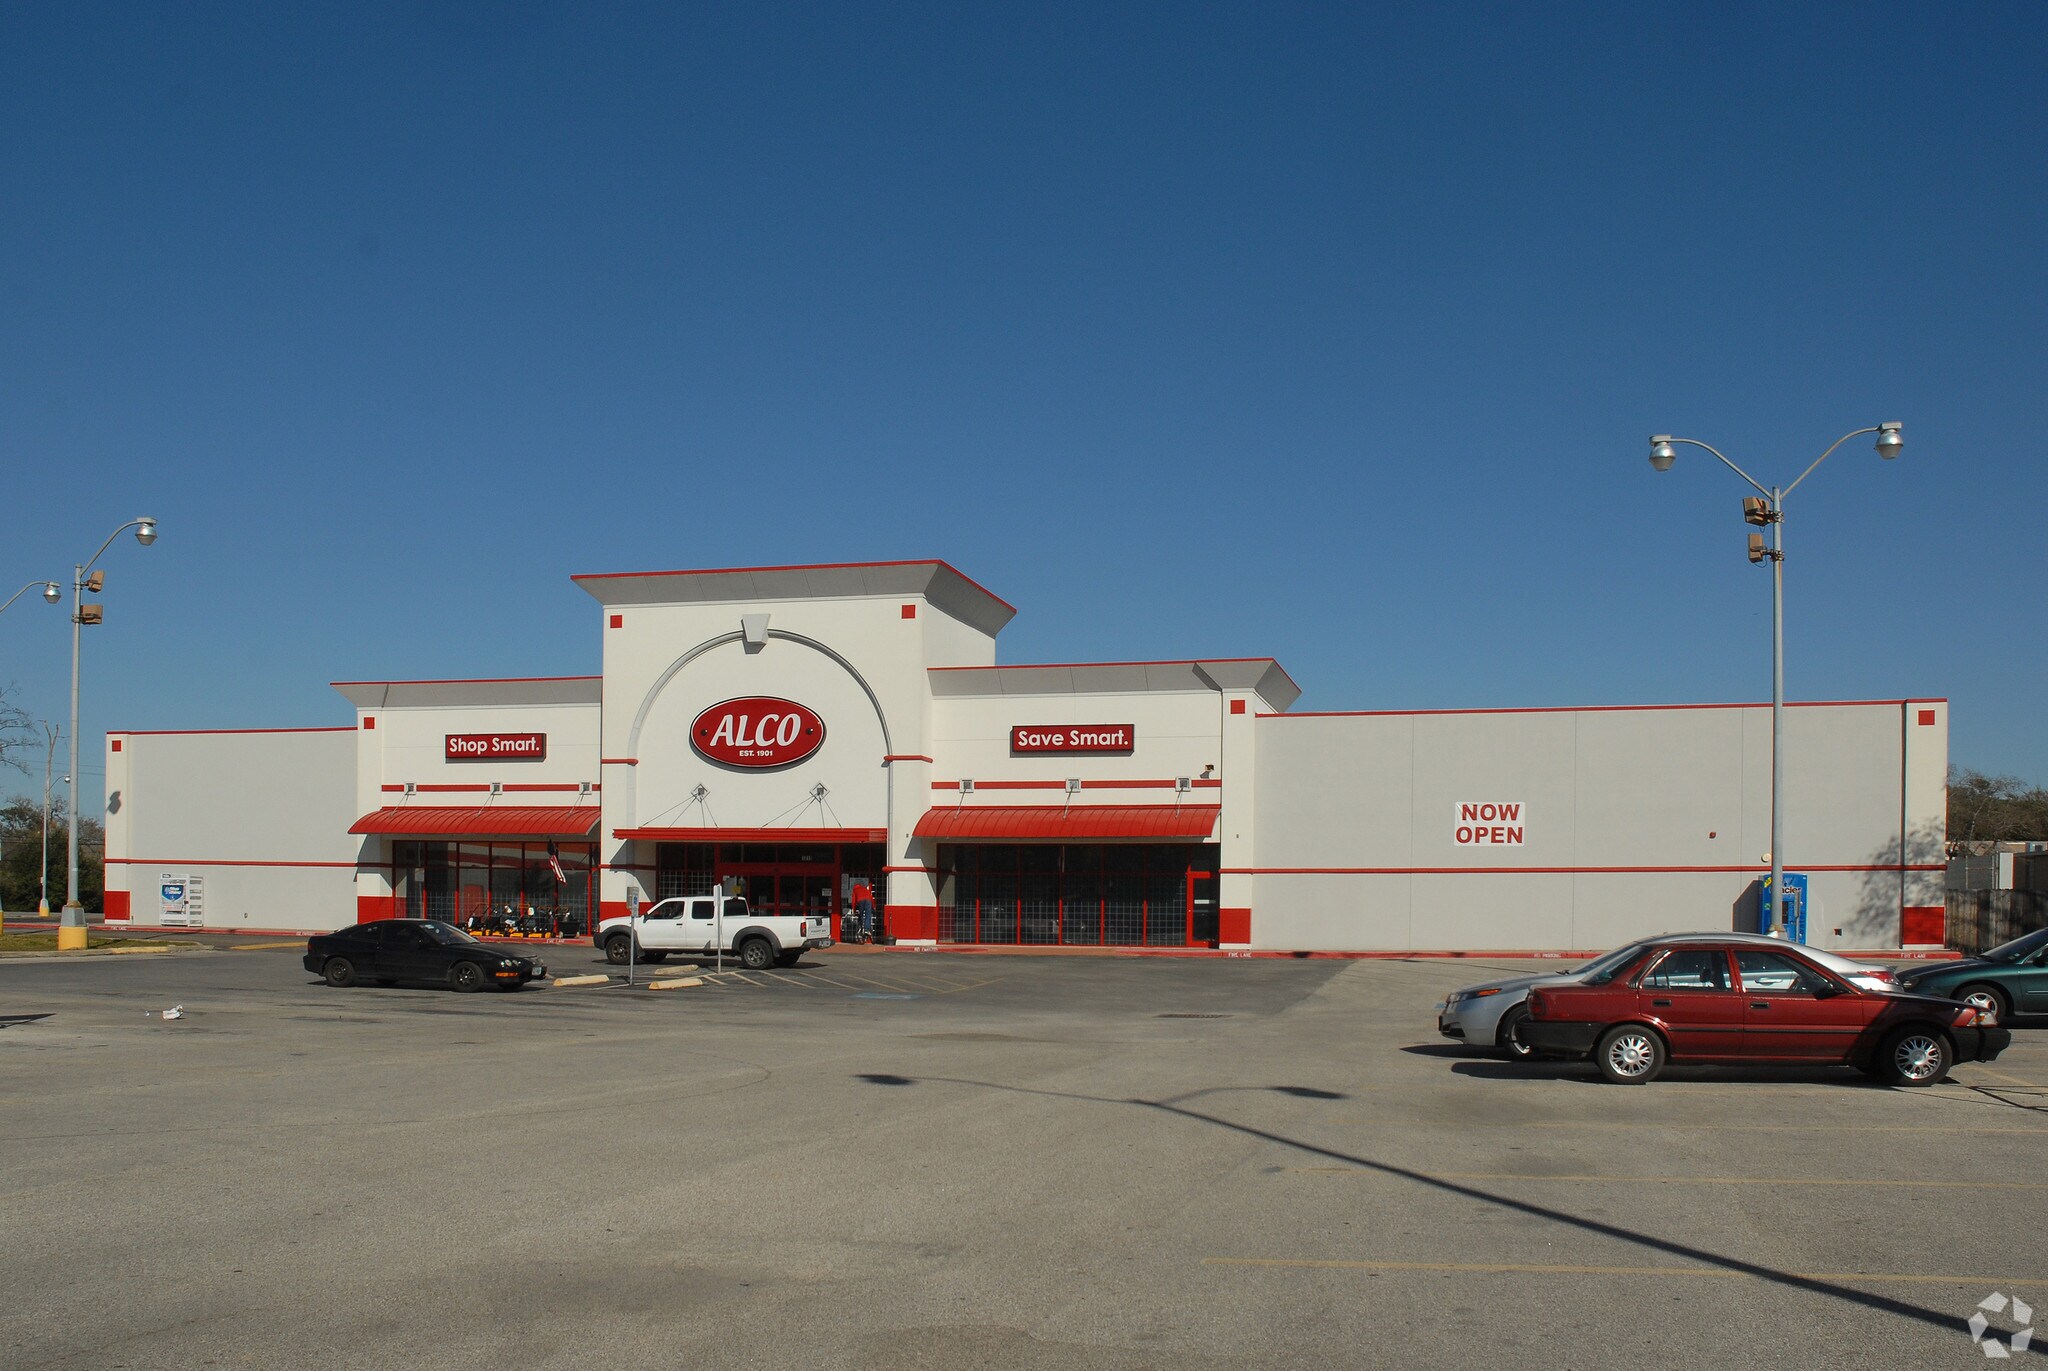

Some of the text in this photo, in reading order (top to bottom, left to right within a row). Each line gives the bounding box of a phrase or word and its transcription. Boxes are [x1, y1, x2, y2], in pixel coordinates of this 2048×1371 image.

[709, 713, 801, 747] ALCO
[1018, 729, 1128, 746] Save Smart.
[449, 736, 540, 755] Shop Smart.
[1461, 803, 1520, 821] NOW
[1455, 826, 1523, 844] OPEN
